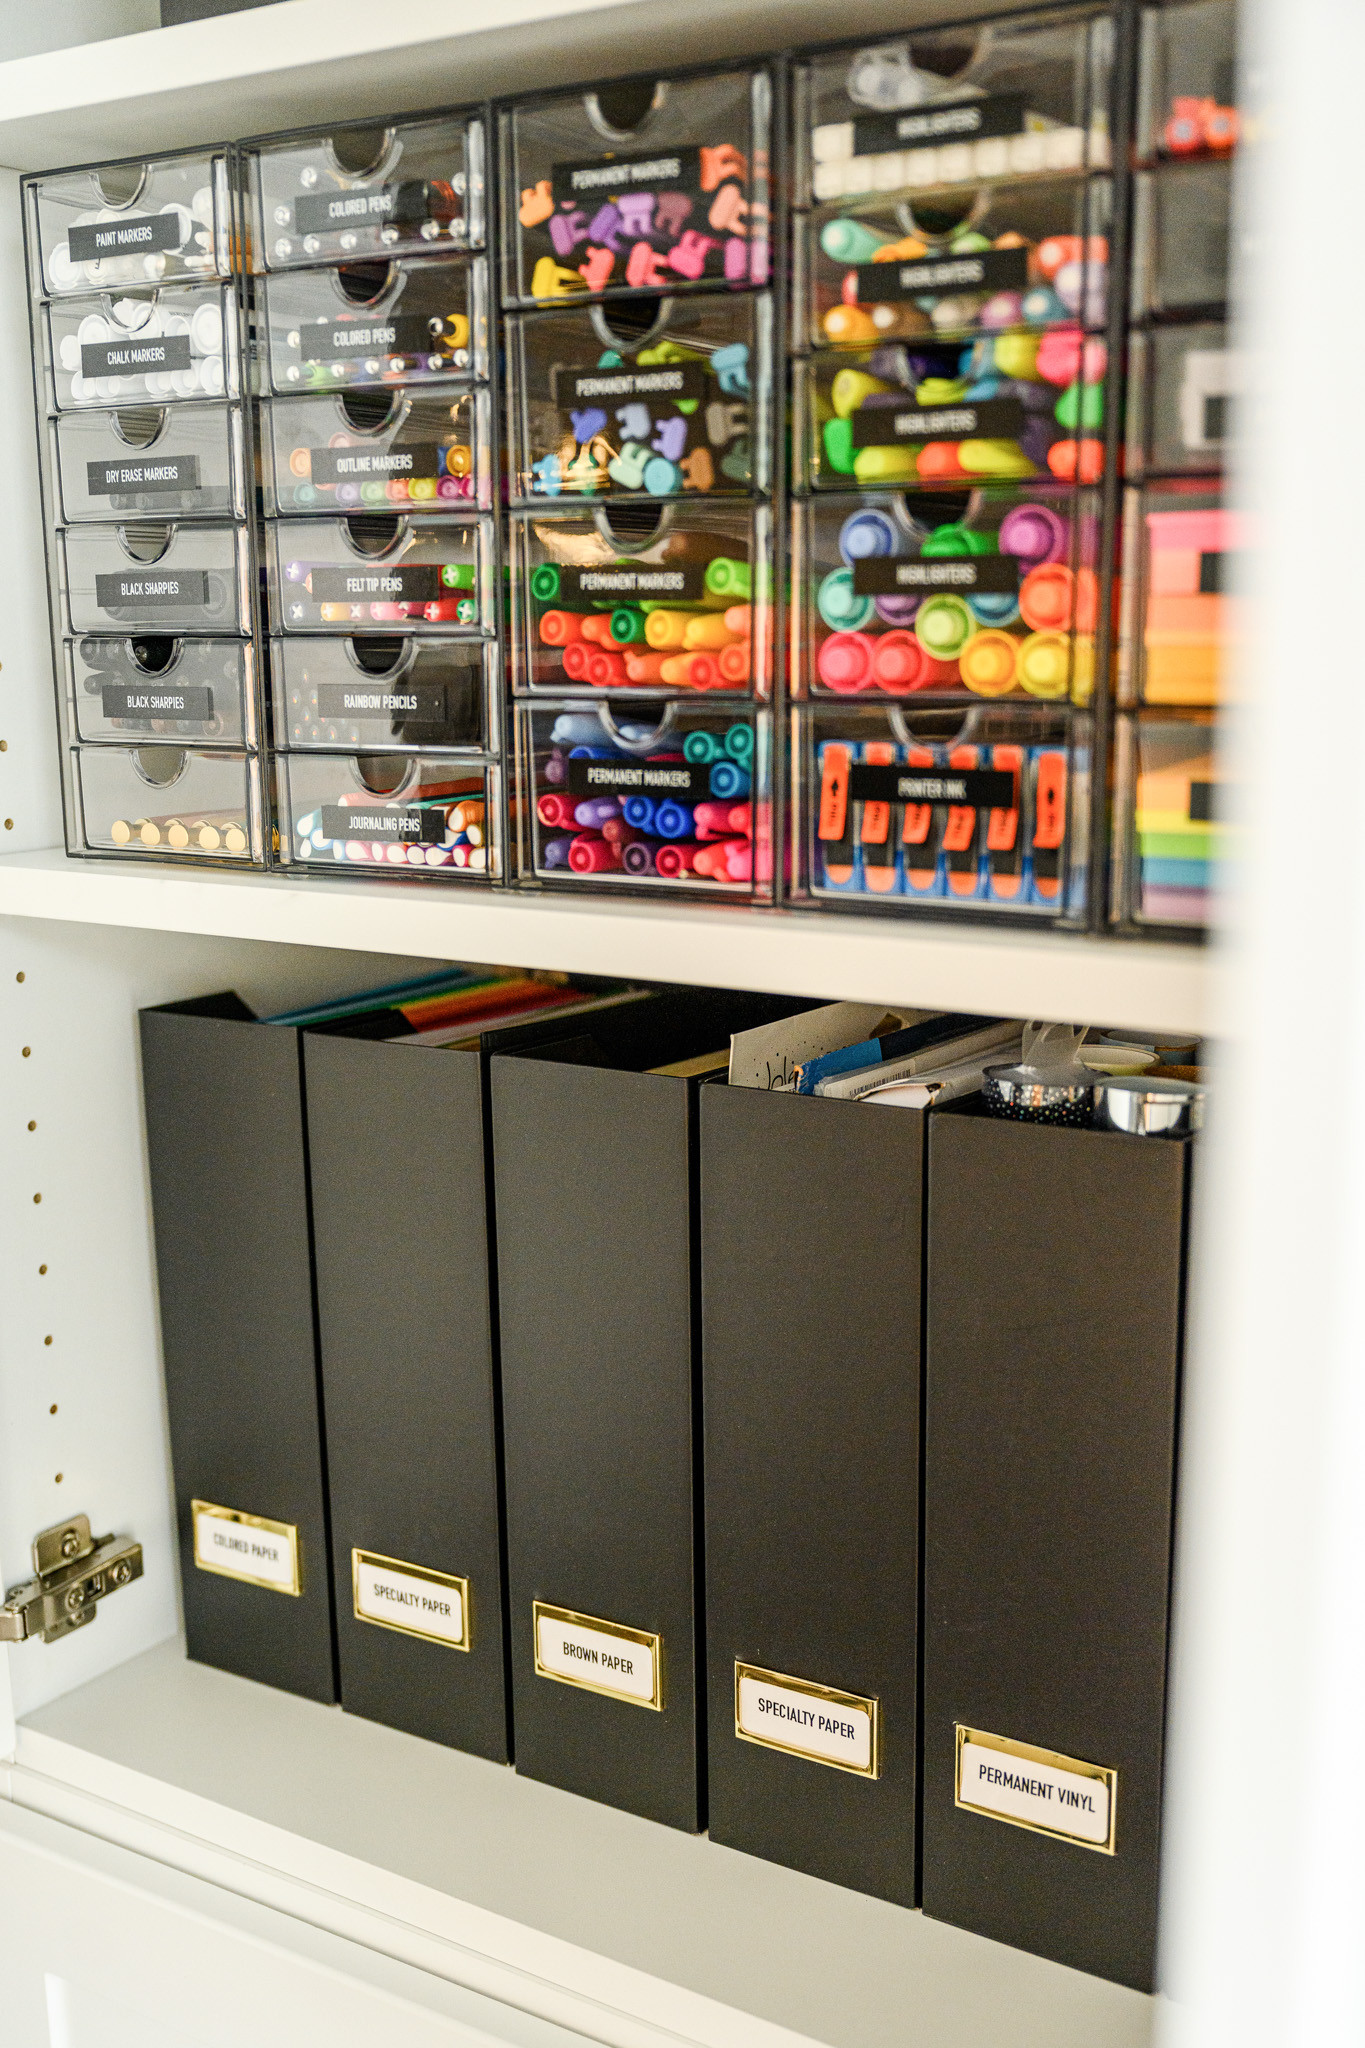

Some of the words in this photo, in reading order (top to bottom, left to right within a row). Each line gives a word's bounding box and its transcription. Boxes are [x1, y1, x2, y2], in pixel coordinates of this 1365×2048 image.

[329, 198, 367, 218] COLORED
[369, 195, 393, 214] PENS
[96, 231, 116, 248] PAINT
[117, 227, 153, 245] MARKERS
[333, 329, 370, 347] COLORED
[372, 327, 396, 345] PENS
[107, 350, 130, 366] CHALK
[131, 346, 165, 363] MARKERS
[337, 457, 370, 472] OUTLINE
[371, 455, 413, 470] MARKERS
[105, 469, 119, 483] DRY
[121, 467, 143, 482] ERASE
[144, 466, 178, 481] MARKERS
[121, 582, 143, 596] BLACK
[145, 581, 179, 595] SHARPIES
[346, 578, 367, 592] FELT
[368, 577, 380, 592] TIP
[382, 577, 403, 592] PENS
[579, 572, 635, 590] PERMANENT
[637, 571, 685, 590] MARKERS
[127, 696, 149, 710] BLACK
[151, 696, 184, 711] SHARPIES
[344, 694, 380, 710] RAINBOW
[382, 694, 418, 711] PENCILS
[587, 767, 642, 787] PERMANENT
[643, 769, 691, 788] MARKERS
[348, 815, 397, 832] JOURNALING
[398, 816, 421, 833] PENS
[213, 1533, 249, 1554] COLORED
[251, 1543, 279, 1561] PAPER
[373, 1584, 420, 1607] SPECIALTY
[422, 1598, 451, 1617] PAPER
[563, 1641, 599, 1664] BROWN
[601, 1653, 634, 1675] PAPER
[758, 1698, 815, 1727] SPECIALTY
[818, 1717, 855, 1740] PAPER
[979, 1764, 1054, 1800] PERMANENT
[1058, 1788, 1096, 1813] VINYL
